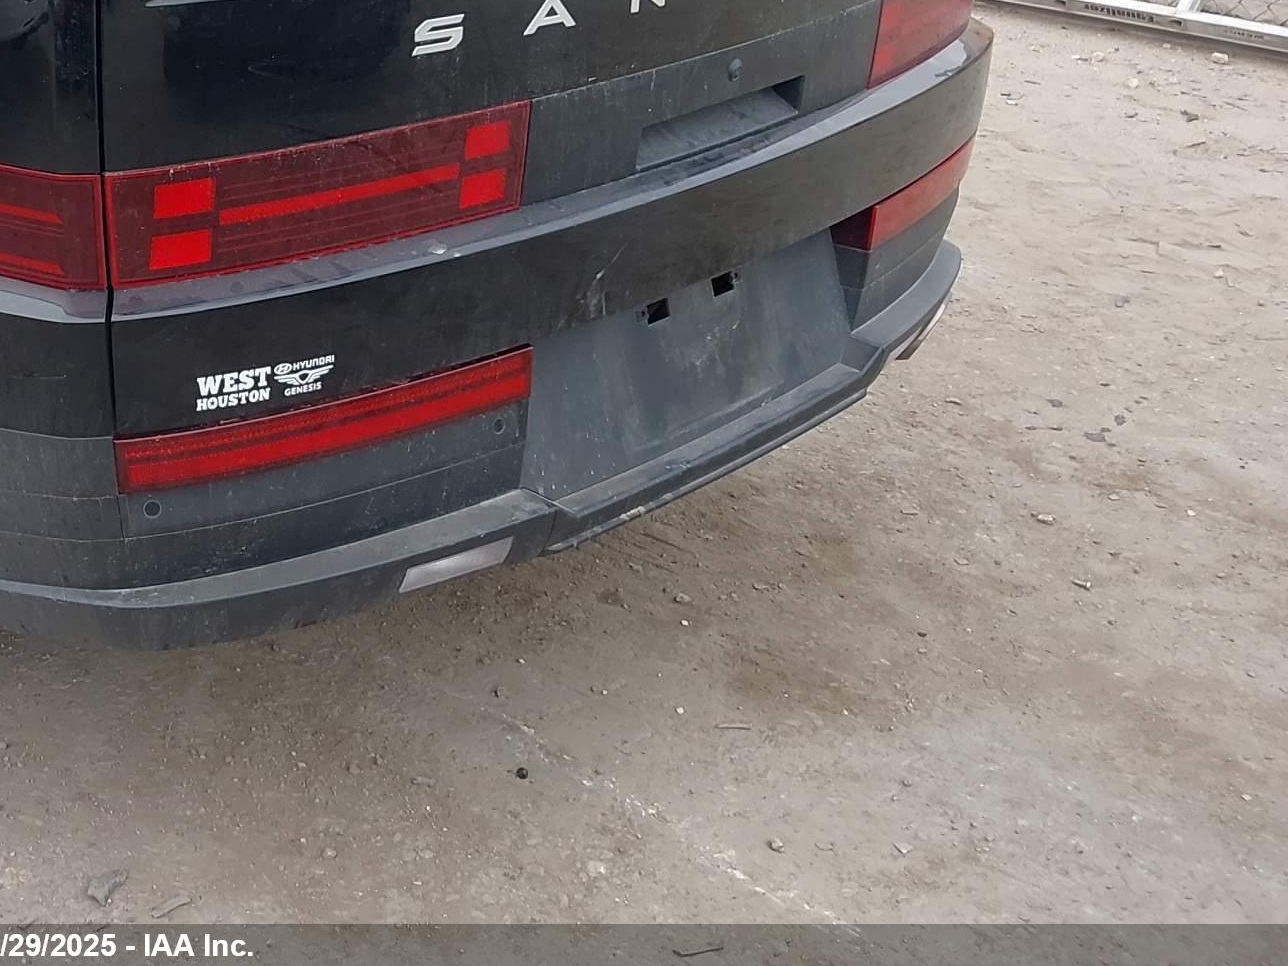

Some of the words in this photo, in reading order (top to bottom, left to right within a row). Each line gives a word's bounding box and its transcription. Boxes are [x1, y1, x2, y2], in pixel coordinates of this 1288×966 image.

[292, 354, 335, 371] HYUNDAI
[196, 366, 272, 396] WEST
[284, 381, 322, 396] GENESIS
[196, 387, 271, 411] HOUSTON
